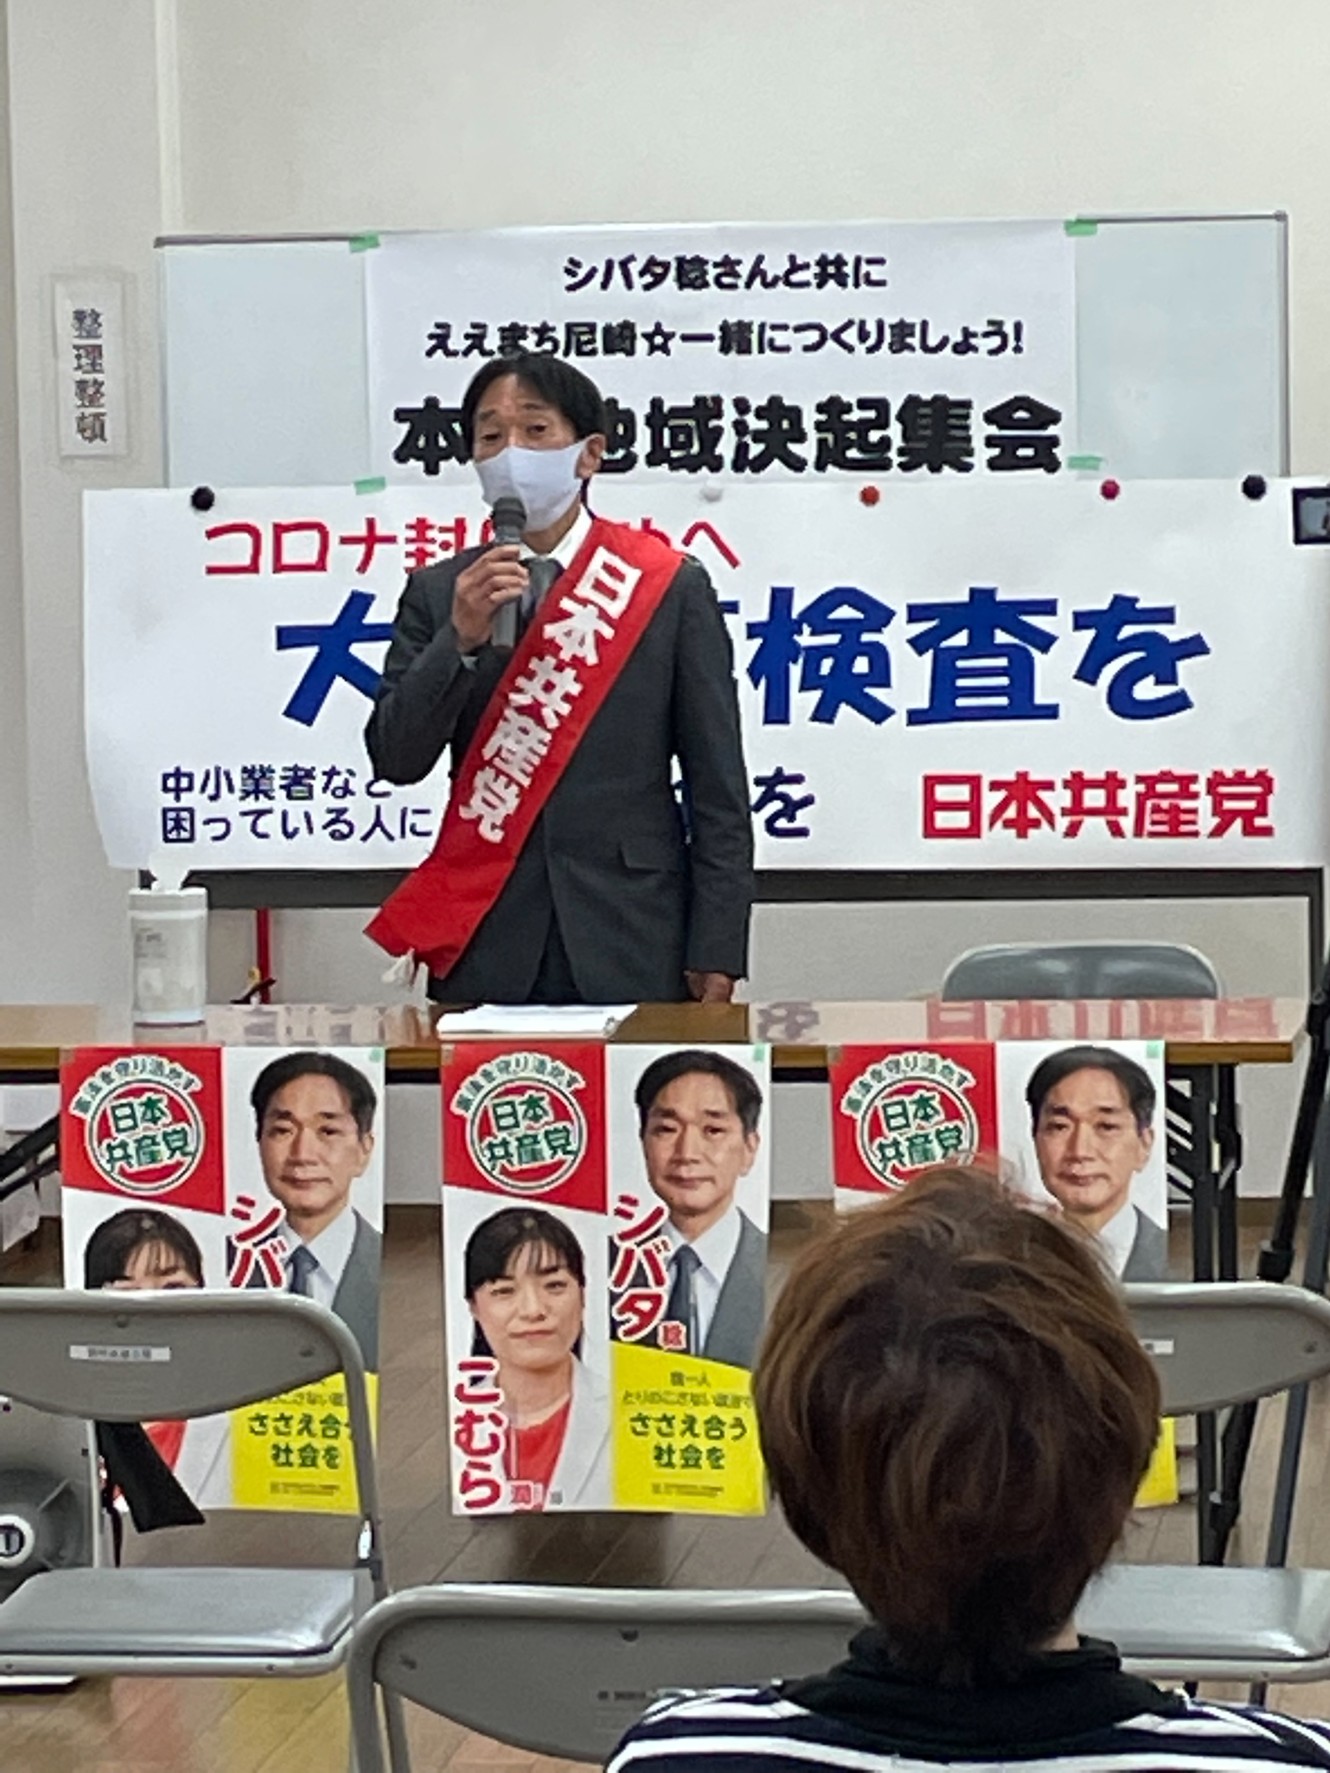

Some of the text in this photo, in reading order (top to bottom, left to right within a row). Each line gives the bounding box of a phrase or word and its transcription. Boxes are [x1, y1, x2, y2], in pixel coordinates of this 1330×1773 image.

[71, 308, 108, 444] 整理整頓
[394, 394, 1062, 475] 本域決起集会
[204, 517, 741, 576] コロナ封へ
[276, 587, 1211, 728] 大検査を
[458, 546, 643, 844] 日本共産党
[161, 805, 434, 843] 困っている人に
[922, 770, 1275, 839] 日本共産党
[110, 1095, 168, 1133] 日本
[492, 1094, 549, 1132] 日本
[881, 1093, 941, 1132] 日本
[105, 1126, 194, 1172] 共産党
[485, 1125, 577, 1171] 共産党
[230, 1195, 287, 1288] シバ
[612, 1195, 669, 1338] シバタ
[248, 1412, 350, 1440] ささえ合
[454, 1360, 506, 1509] こむら
[629, 1412, 748, 1442] ささえ合う
[270, 1441, 341, 1470] 社会を
[653, 1441, 726, 1470] 社会を
